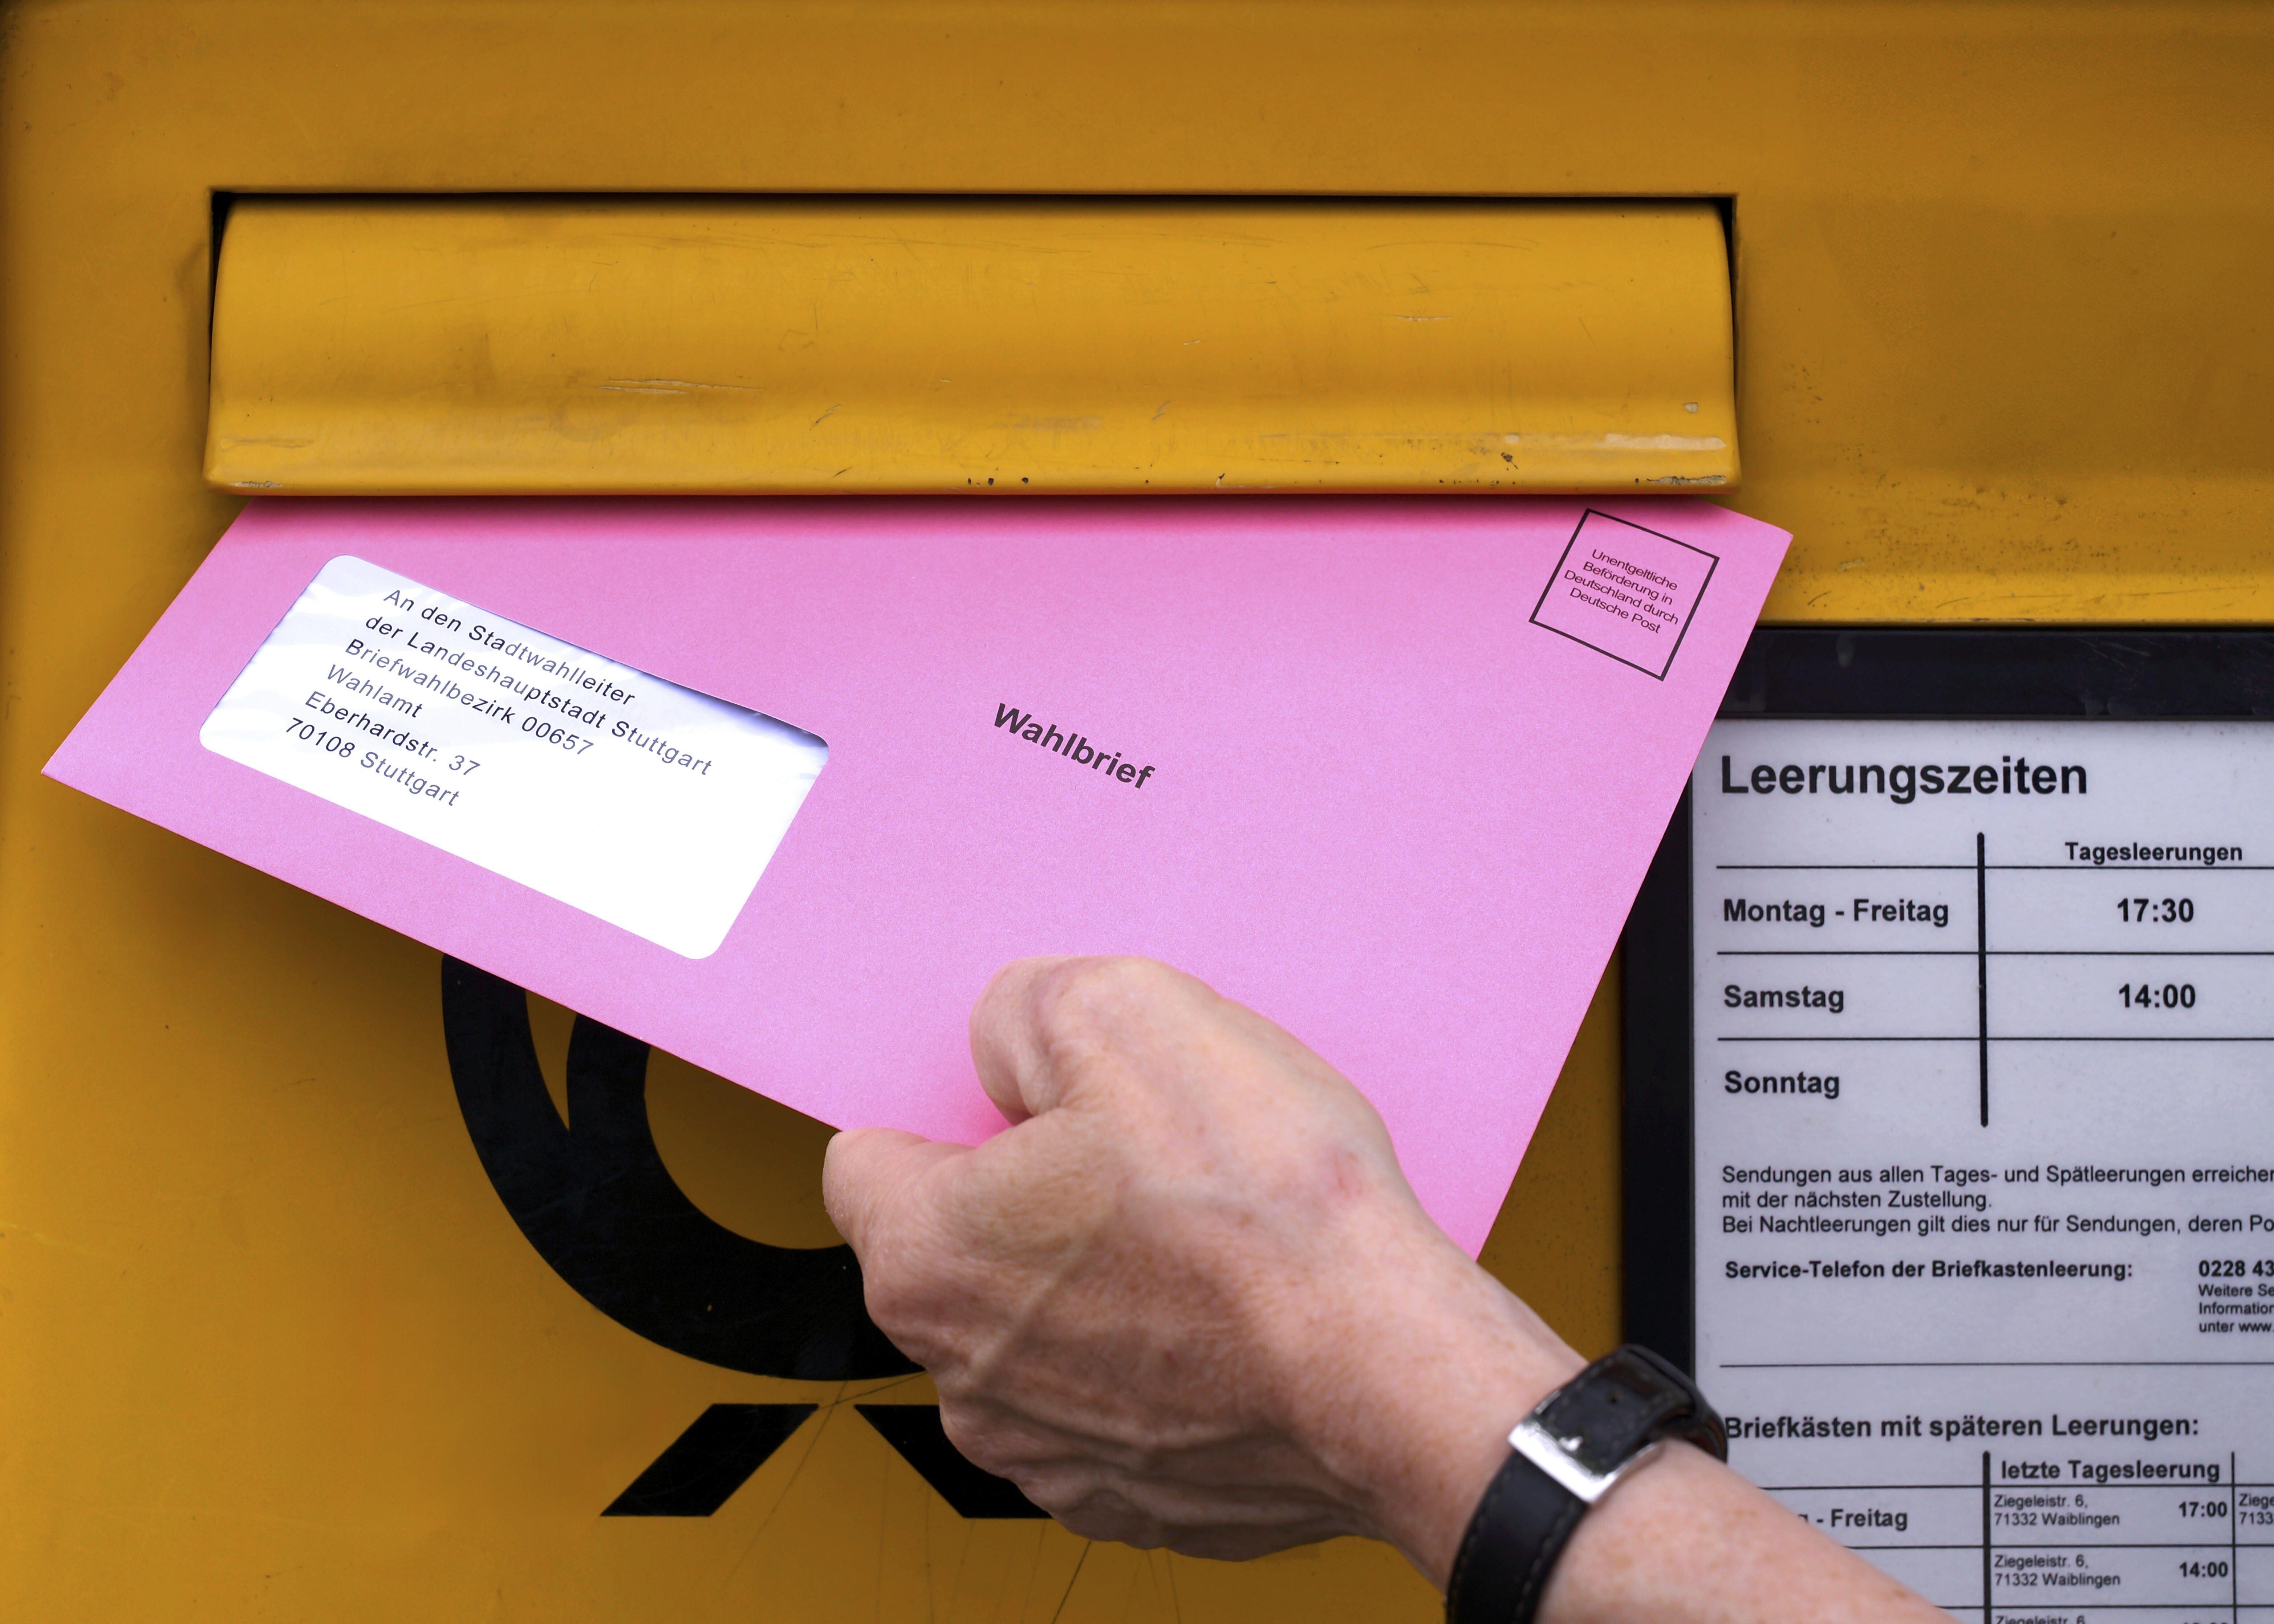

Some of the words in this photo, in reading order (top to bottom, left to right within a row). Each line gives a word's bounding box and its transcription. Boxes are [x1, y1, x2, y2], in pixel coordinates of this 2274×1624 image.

[1592, 549, 1677, 590] Unentgeltliche
[1583, 561, 1659, 601] Beförderung
[1661, 593, 1672, 605] in
[1564, 570, 1642, 608] Deutschland
[1644, 604, 1678, 624] durch
[1570, 587, 1629, 619] Deutsche
[1631, 613, 1661, 633] Post
[383, 590, 414, 611] An
[421, 607, 461, 632] den
[469, 625, 635, 705] Stadtwahlleiter
[328, 664, 422, 718] Wahlamt
[345, 639, 516, 724] Briefwahlbezirk
[522, 717, 594, 754] 00657
[366, 616, 403, 638] der
[407, 632, 606, 728] Landeshauptstadt
[612, 721, 711, 775] Stuttgart
[305, 691, 438, 762] Eberhardstr.
[449, 755, 480, 775] 37
[994, 703, 1156, 789] Wahlbrief
[286, 717, 355, 757] 70108
[361, 752, 459, 806] Stuttgart
[1721, 754, 2087, 804] Leerungszeiten
[2065, 842, 2242, 862] Tagesleerungen
[1724, 899, 1824, 928] Montag
[1854, 899, 1948, 928] Freitag
[2117, 898, 2194, 923] 17:30
[1724, 984, 1844, 1013] Samstag
[2119, 984, 2196, 1008] 14:00
[1725, 1070, 1839, 1099] Sonntag
[1722, 1165, 1831, 1187] Sendungen
[1839, 1170, 1872, 1183] aus
[1880, 1166, 1923, 1183] allen
[1930, 1165, 1997, 1187] Tages-
[2005, 1165, 2039, 1183] und
[2047, 1165, 2185, 1187] Spätleerungen
[1723, 1191, 1750, 1208] mit
[1757, 1191, 1788, 1208] der
[1795, 1191, 1881, 1208] nächsten
[1888, 1190, 1991, 1212] Zustellung.
[1723, 1216, 1752, 1233] Bei
[1760, 1215, 1910, 1237] Nachtleerungen
[1918, 1215, 1945, 1237] gilt
[1952, 1215, 1990, 1232] dies
[1998, 1219, 2028, 1232] nur
[2034, 1215, 2060, 1232] für
[2067, 1215, 2180, 1236] Sendungen,
[2188, 1215, 2242, 1232] deren
[2250, 1214, 2274, 1232] Po
[1725, 1260, 1884, 1279] Service-Telefon
[1892, 1261, 1925, 1277] der
[1932, 1260, 2132, 1281] Briefkastenleerung:
[2199, 1260, 2245, 1277] 0228
[2252, 1260, 2274, 1277] 43
[2198, 1284, 2253, 1297] Weitere
[2258, 1283, 2274, 1297] Se
[2199, 1320, 2234, 1333] unter
[1725, 1416, 1871, 1438] Briefkästen
[1881, 1415, 1922, 1437] mit
[1930, 1415, 2042, 1442] späteren
[2052, 1415, 2198, 1441] Leerungen:
[2002, 1461, 2060, 1479] letzte
[2068, 1460, 2220, 1482] Tagesleerung
[1994, 1494, 2069, 1511] Ziegeleistr.
[2075, 1494, 2087, 1508] 6,
[2179, 1501, 2228, 1517] 17:00
[1831, 1509, 1907, 1531] Freitag
[1994, 1513, 2037, 1526] 71332
[2042, 1513, 2120, 1528] Waiblingen
[2240, 1511, 2274, 1525] 7133
[1994, 1555, 2069, 1571] Ziegeleistr.
[2076, 1554, 2088, 1568] 6,
[2180, 1562, 2228, 1578] 14:00
[1995, 1573, 2038, 1586] 71332
[2042, 1573, 2120, 1589] Waiblingen
